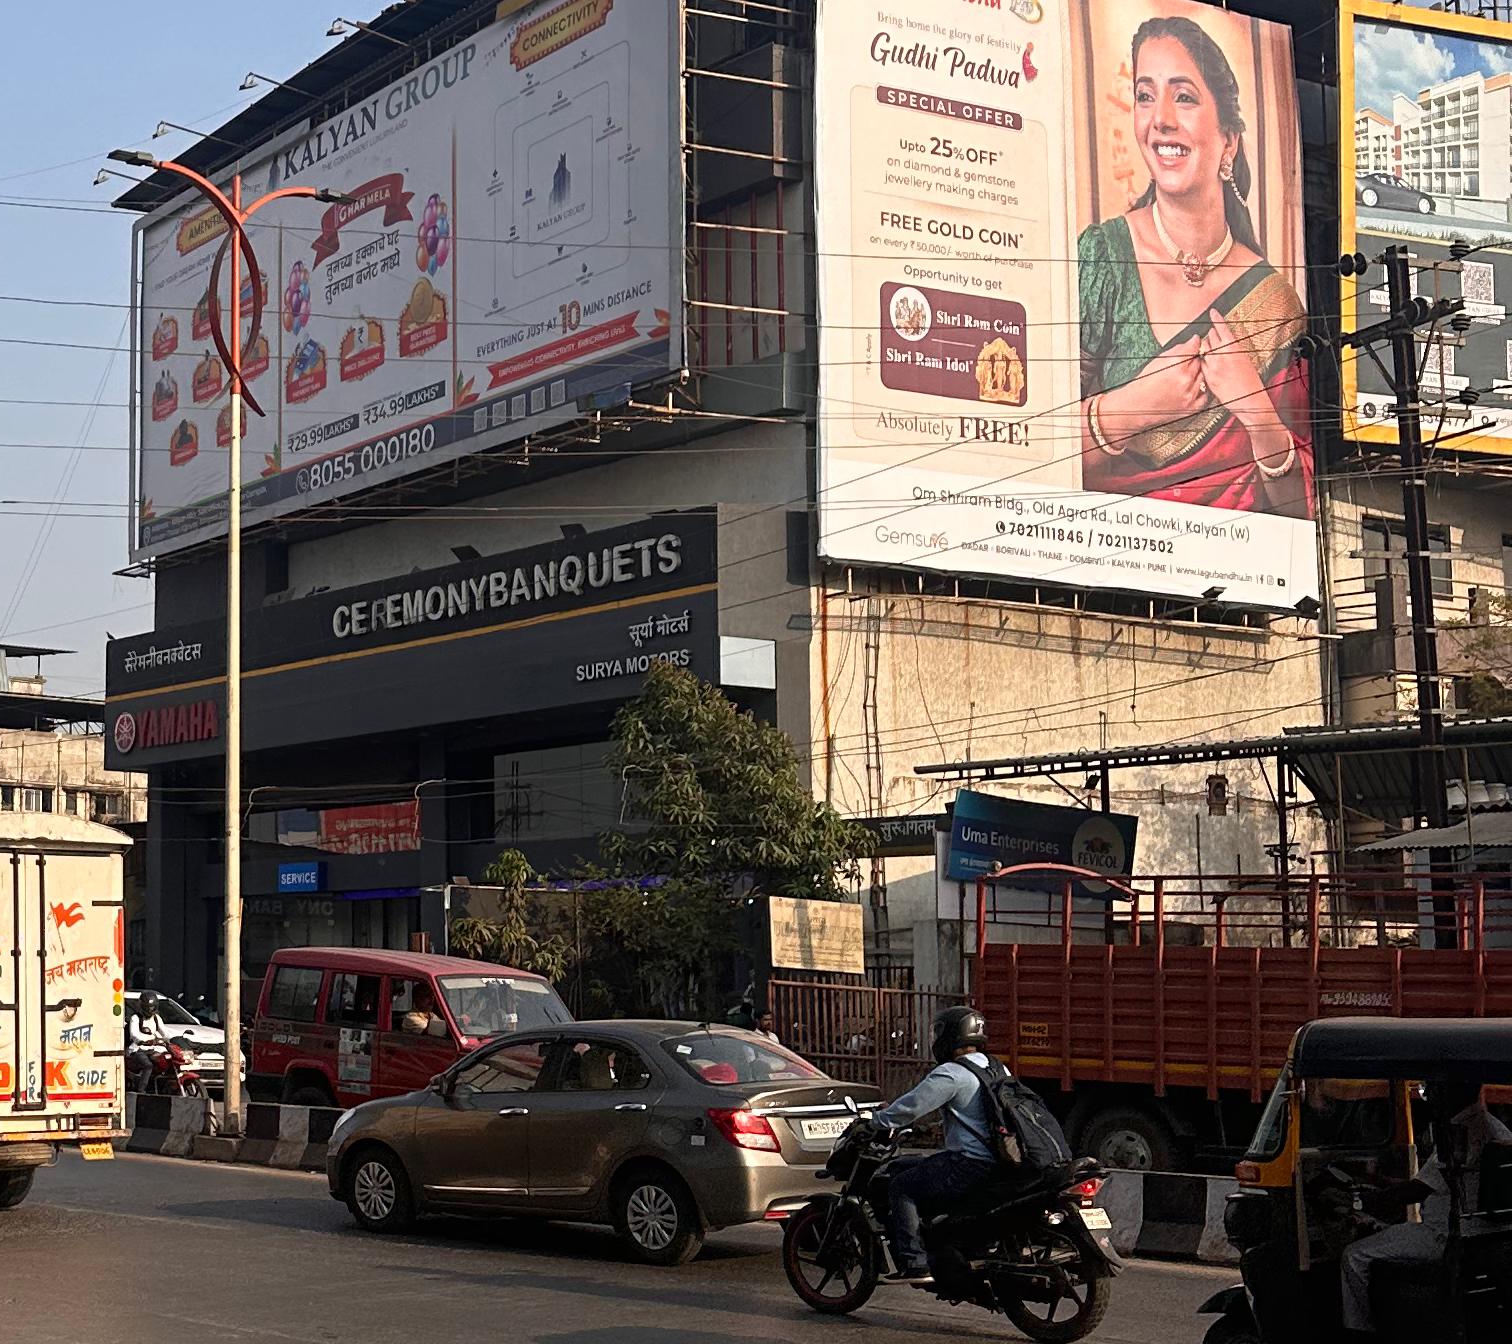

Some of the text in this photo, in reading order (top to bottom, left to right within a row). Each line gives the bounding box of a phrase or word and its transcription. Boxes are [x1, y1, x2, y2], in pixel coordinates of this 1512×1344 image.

[522, 0, 600, 52] CONNECTIVITY
[877, 11, 1022, 54] Bring home the glory of festivity
[870, 32, 1021, 88] Gudhi Padwa
[284, 43, 477, 181] KALYAN GROUP
[887, 90, 1014, 128] SPECIAL OFFER
[899, 138, 926, 154] Upto
[887, 156, 1016, 189] on diamond & gemstone
[884, 170, 1019, 206] jewellery making charges
[537, 214, 564, 232] KALYAN
[880, 211, 922, 233] FREE
[927, 220, 974, 240] GOLD
[869, 235, 882, 244] on
[884, 238, 908, 251] every
[325, 273, 354, 304] तुमच्या
[904, 265, 1002, 291] Opportunity to get
[477, 280, 652, 358] EVERYTHING JUST AT 10 MINS DISTANCE
[936, 311, 961, 327] Shri
[965, 315, 991, 331] Ram
[886, 347, 912, 364] Shri
[915, 352, 942, 368] Ram
[363, 397, 405, 425] ₹34.99
[288, 426, 325, 453] ₹29.99
[877, 412, 1029, 447] Absolutely FREE!
[310, 423, 435, 490] 8055 000180
[912, 486, 936, 501] Om
[940, 490, 992, 506] Shriram
[995, 495, 1029, 516] Bldg.,
[1033, 501, 1054, 515] Old
[1058, 506, 1088, 522] Agra
[1091, 509, 1113, 525] Rd.,
[1116, 512, 1133, 525] Lal
[1136, 513, 1183, 534] Chowki,
[1185, 520, 1227, 540] Kalyan
[875, 524, 949, 551] Gemsure
[1009, 522, 1084, 544] 7021111846
[1097, 533, 1174, 554] 7021137502
[1111, 558, 1141, 571] KALYAN
[1147, 561, 1167, 574] PUNE
[629, 610, 689, 647] सूर्या मोटर्स
[576, 659, 623, 682] SURYA
[137, 699, 218, 748] YAMAHA
[961, 826, 1060, 855] Uma Enterprises
[1077, 850, 1119, 869] FEVICOL
[281, 872, 316, 885] SERVICE
[45, 956, 110, 985] जय महाराष्ट्र
[60, 1024, 93, 1048] महान
[46, 1061, 70, 1087] K
[77, 1070, 108, 1086] SIDE
